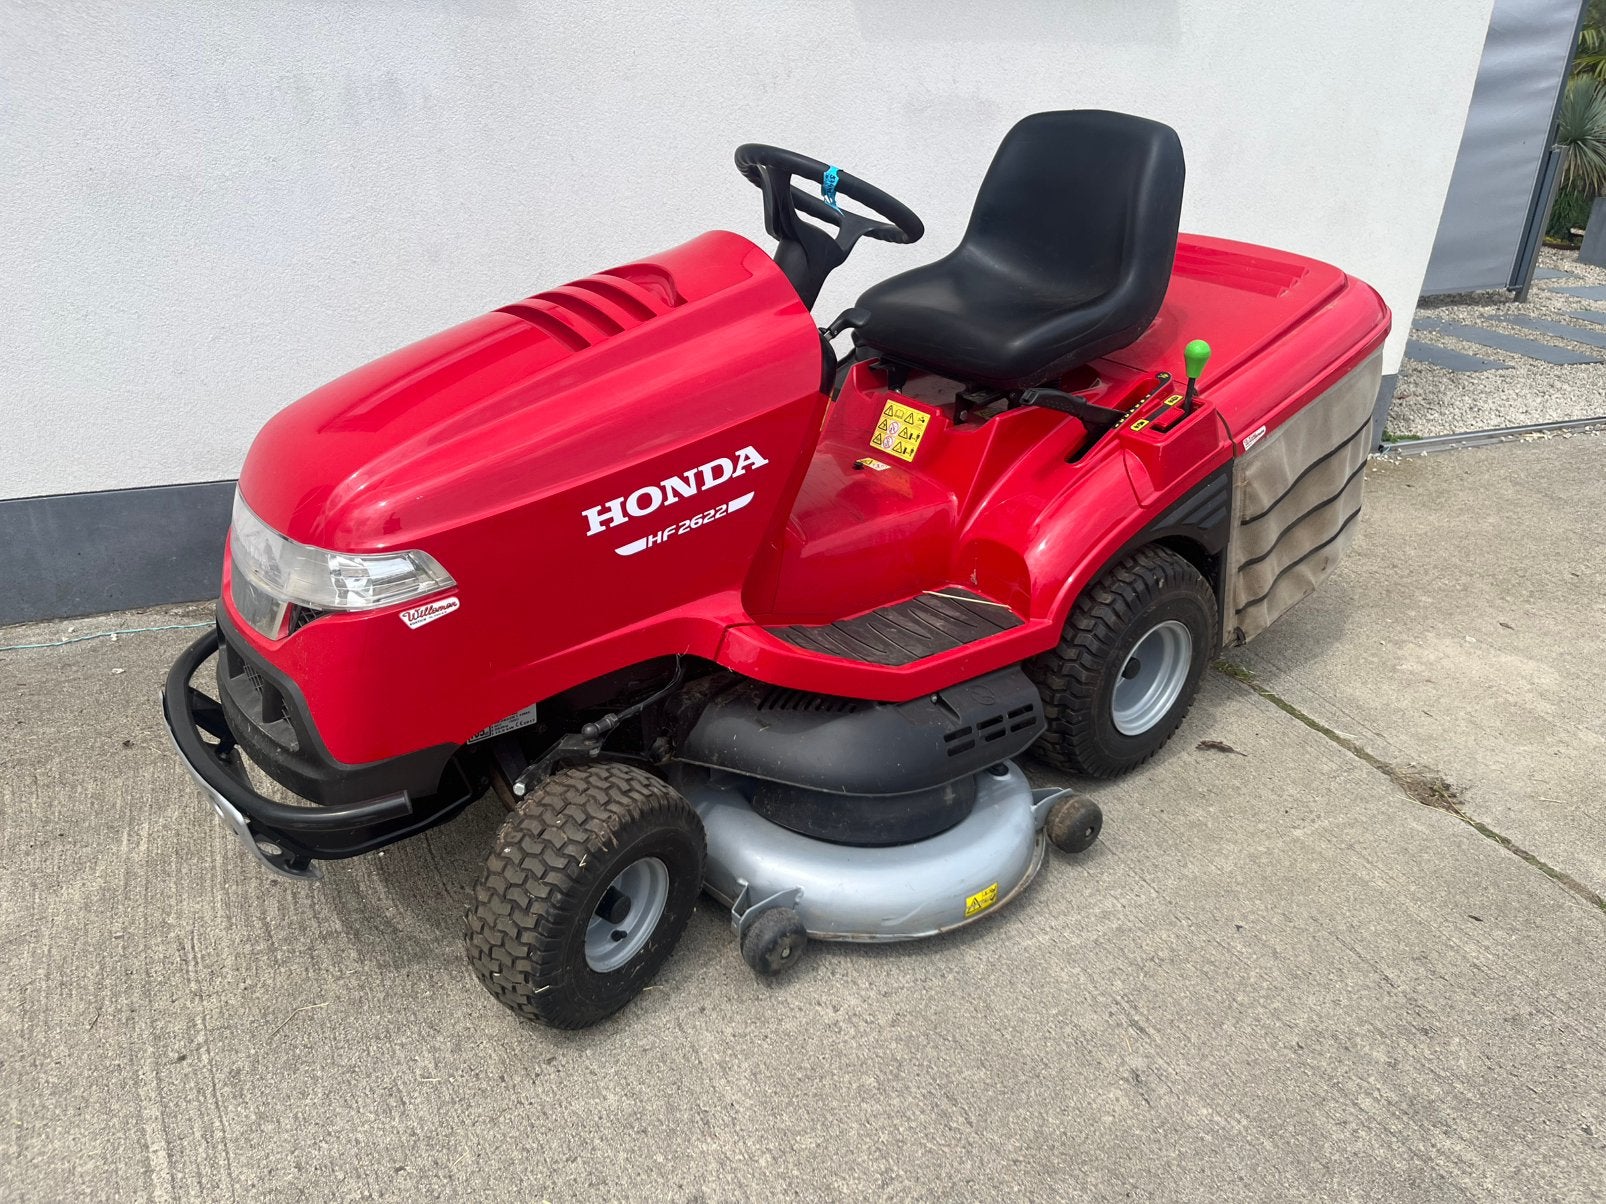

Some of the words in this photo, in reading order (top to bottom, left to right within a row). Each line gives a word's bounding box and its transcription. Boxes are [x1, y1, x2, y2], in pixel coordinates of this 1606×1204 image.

[582, 445, 769, 537] HONDA
[647, 524, 677, 548] HF
[677, 504, 728, 535] 2622
